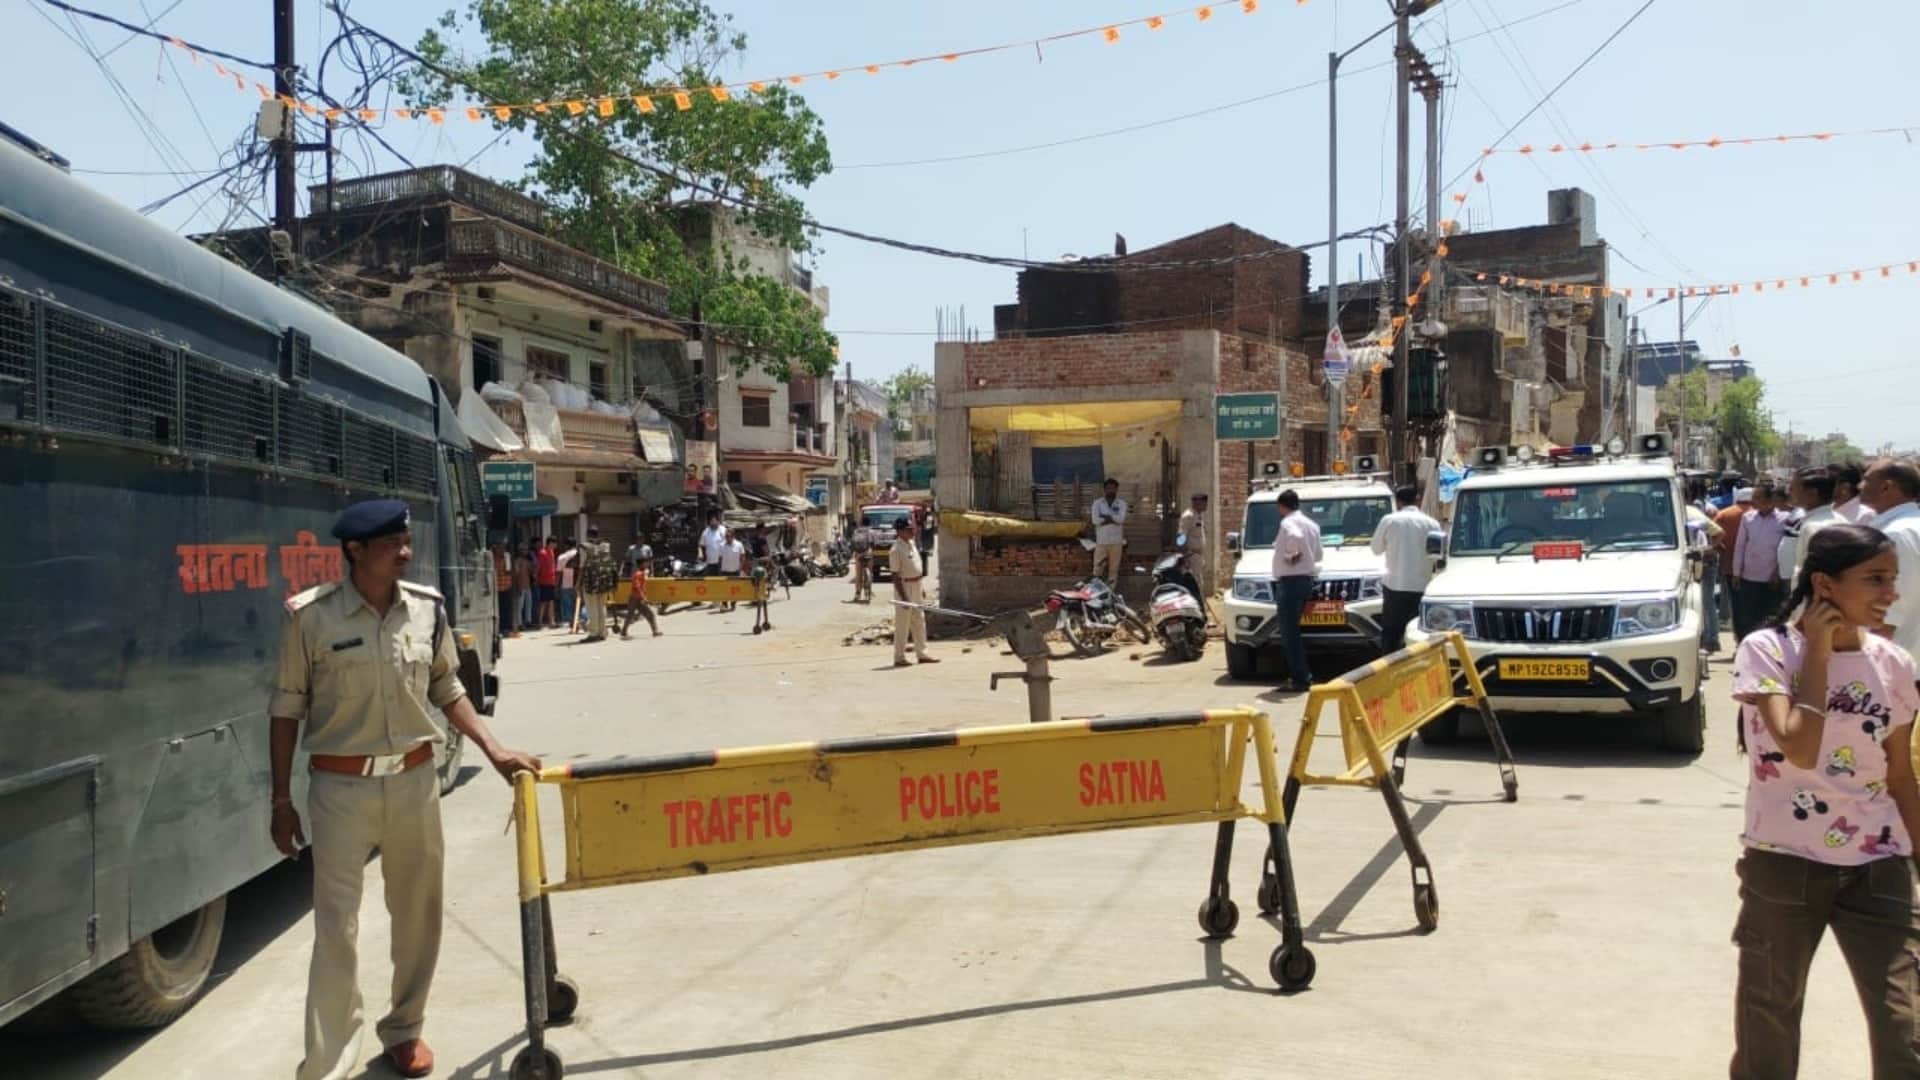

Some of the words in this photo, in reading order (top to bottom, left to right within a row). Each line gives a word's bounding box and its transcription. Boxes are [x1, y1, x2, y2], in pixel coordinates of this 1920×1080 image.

[176, 543, 269, 593] सतना
[664, 791, 793, 848] TRAFFIC
[900, 769, 1000, 821] POLICE
[1079, 760, 1167, 807] SATNA
